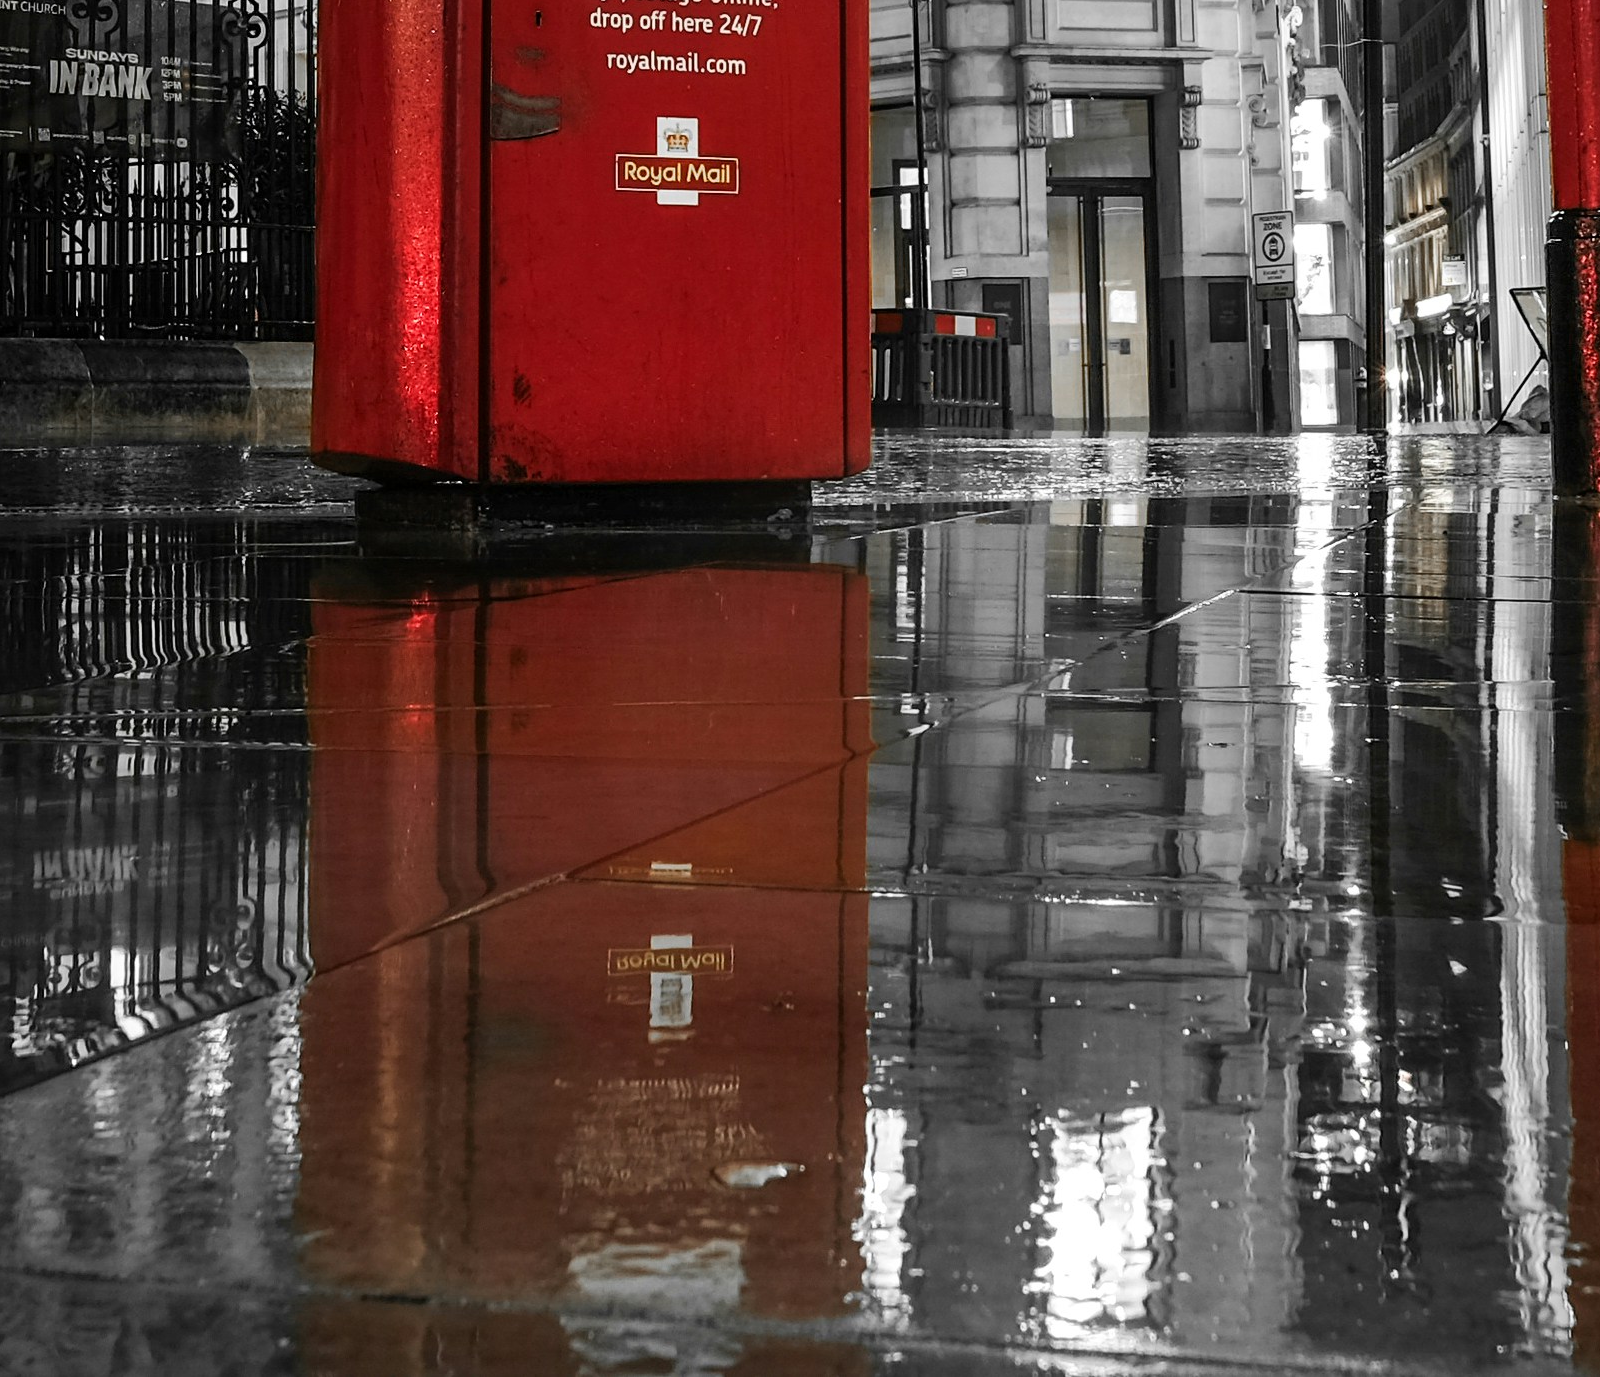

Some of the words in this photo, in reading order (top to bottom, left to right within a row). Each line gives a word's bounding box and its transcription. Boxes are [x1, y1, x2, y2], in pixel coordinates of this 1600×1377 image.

[20, 0, 66, 15] CHURCH
[589, 7, 634, 34] drop
[639, 10, 667, 31] off
[671, 11, 714, 34] here
[718, 14, 763, 37] 24/7
[65, 47, 139, 64] SUNDAYS
[606, 50, 747, 75] royalmail.com
[49, 59, 79, 95] IN
[81, 61, 153, 101] BANK
[623, 161, 682, 186] Royal
[686, 163, 731, 184] Mail
[1263, 222, 1283, 231] ZONE
